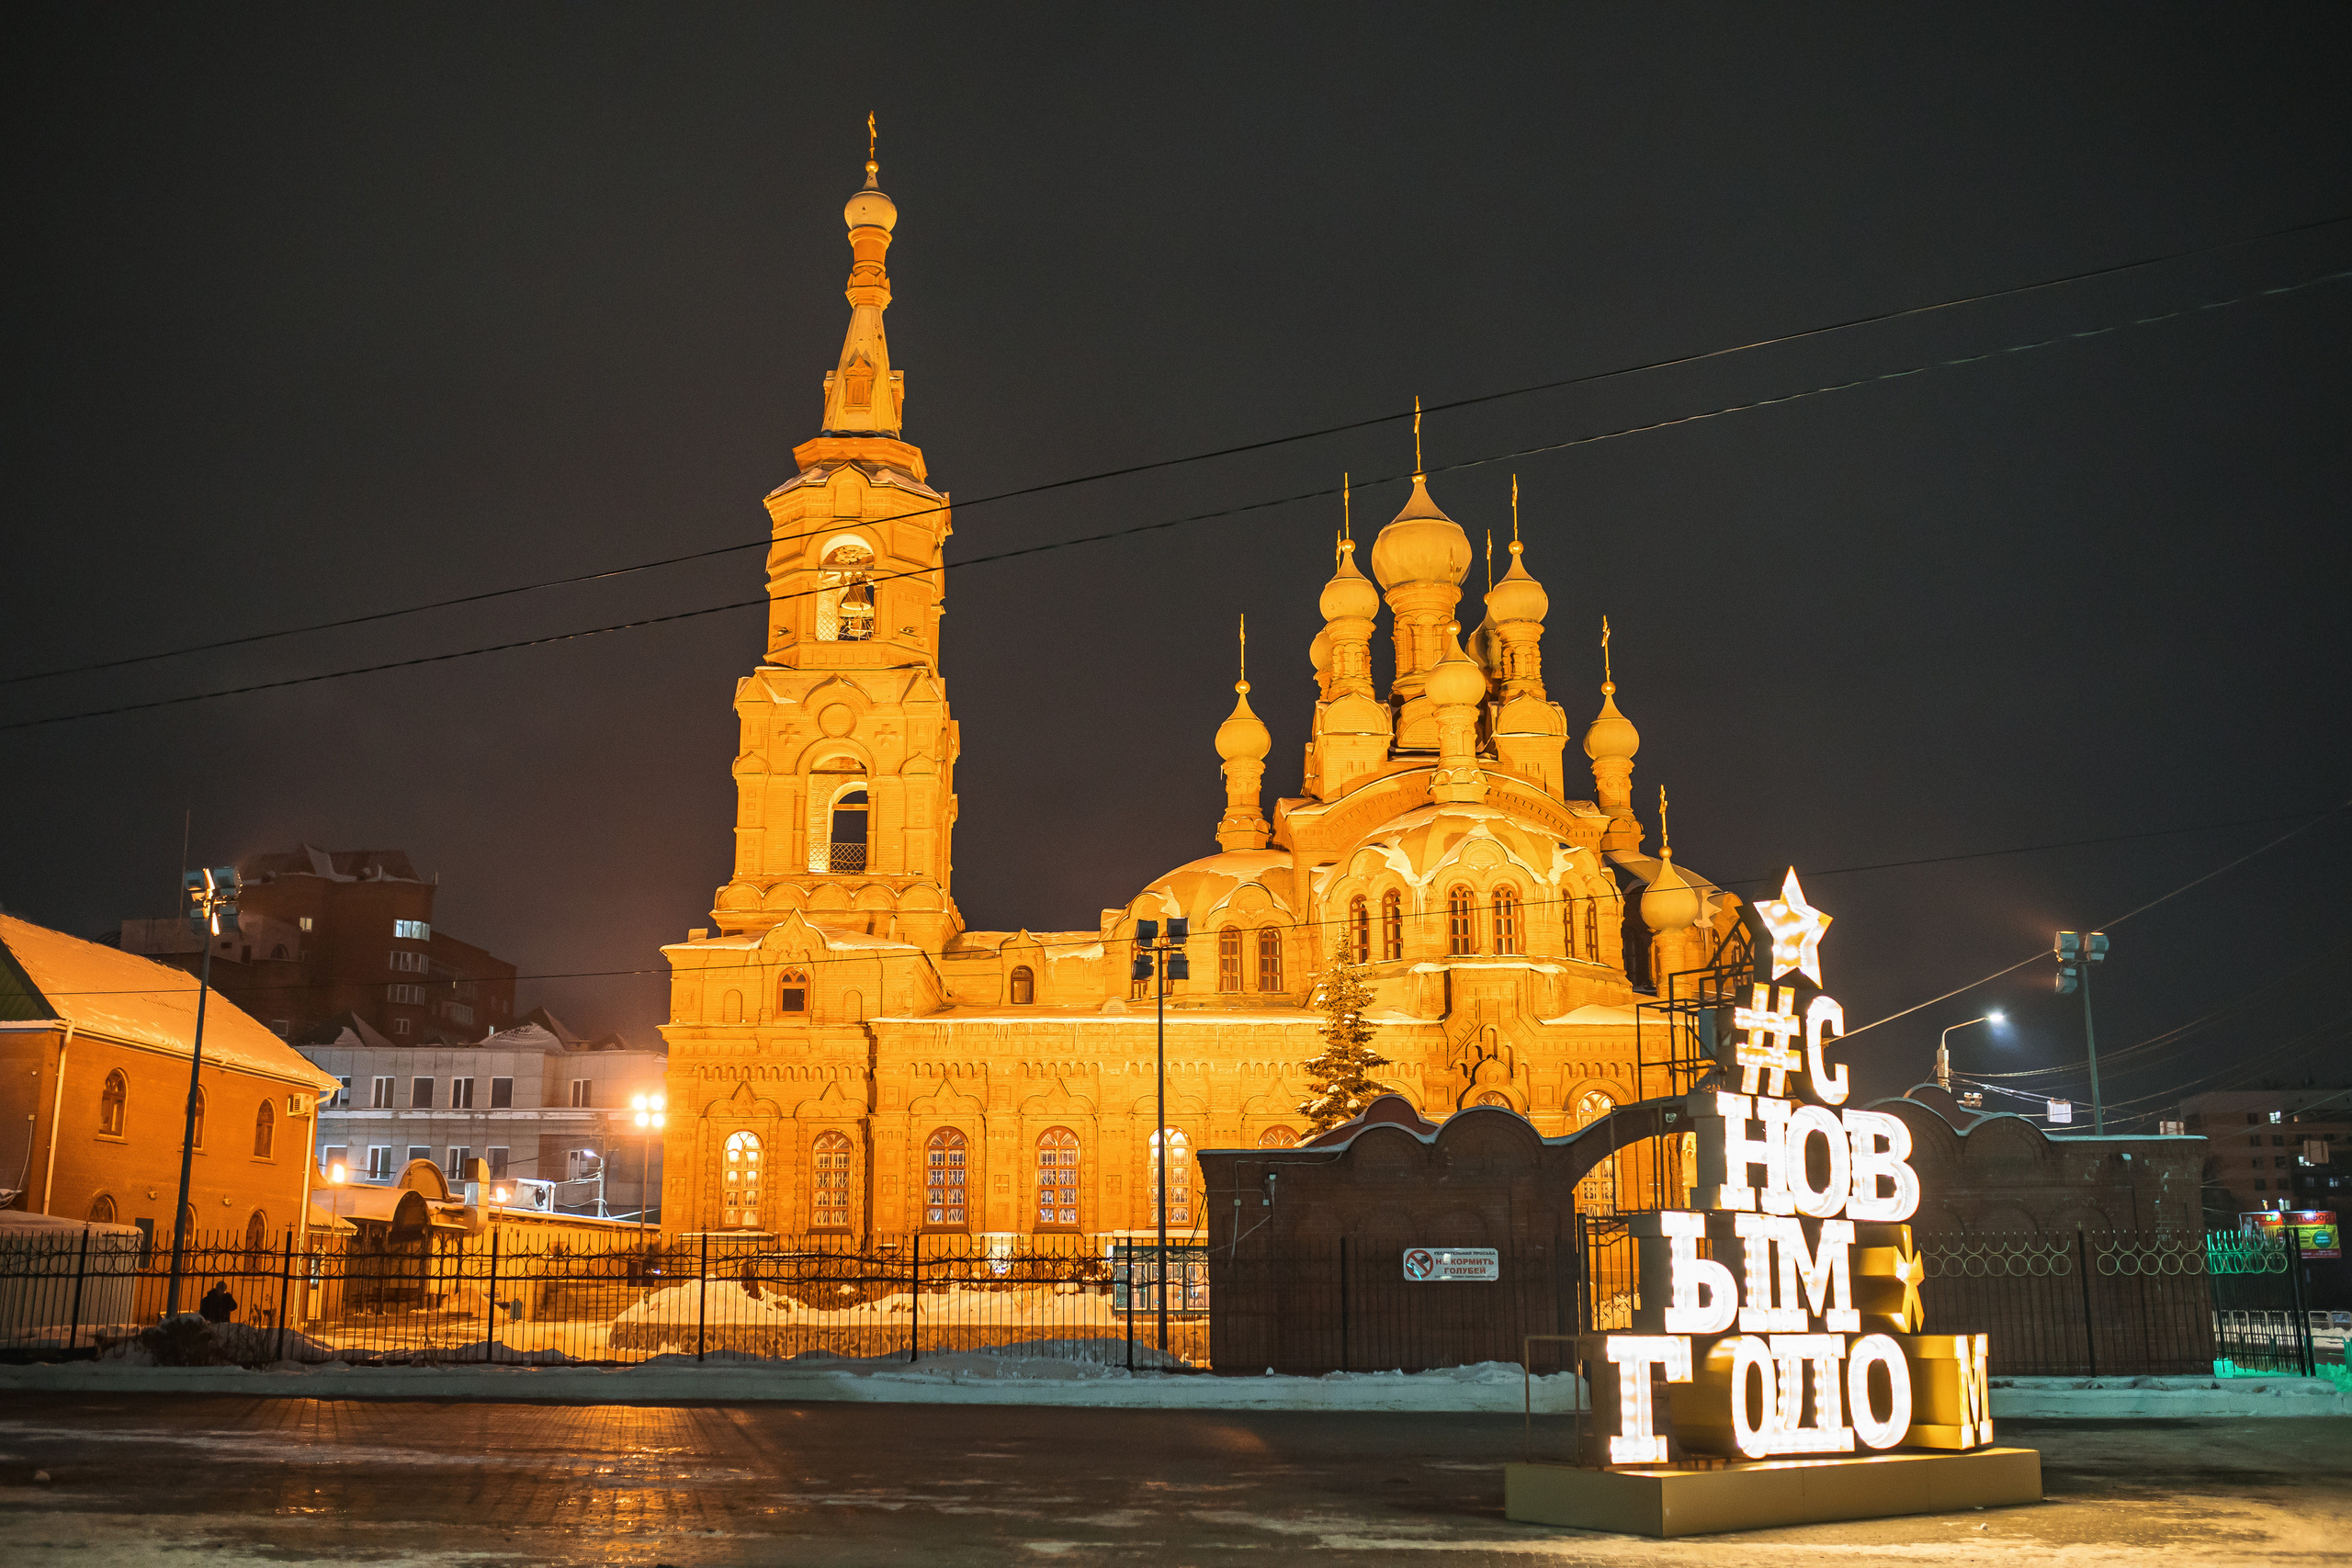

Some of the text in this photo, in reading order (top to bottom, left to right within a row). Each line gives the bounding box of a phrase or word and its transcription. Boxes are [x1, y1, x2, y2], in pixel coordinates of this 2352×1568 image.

[1735, 983, 1849, 1105] #С
[1716, 1091, 1920, 1222] НОВ
[1661, 1212, 1860, 1333] ЫМ
[2281, 1214, 2331, 1223] сетофор
[1607, 1333, 1994, 1463] ГОДОМ
